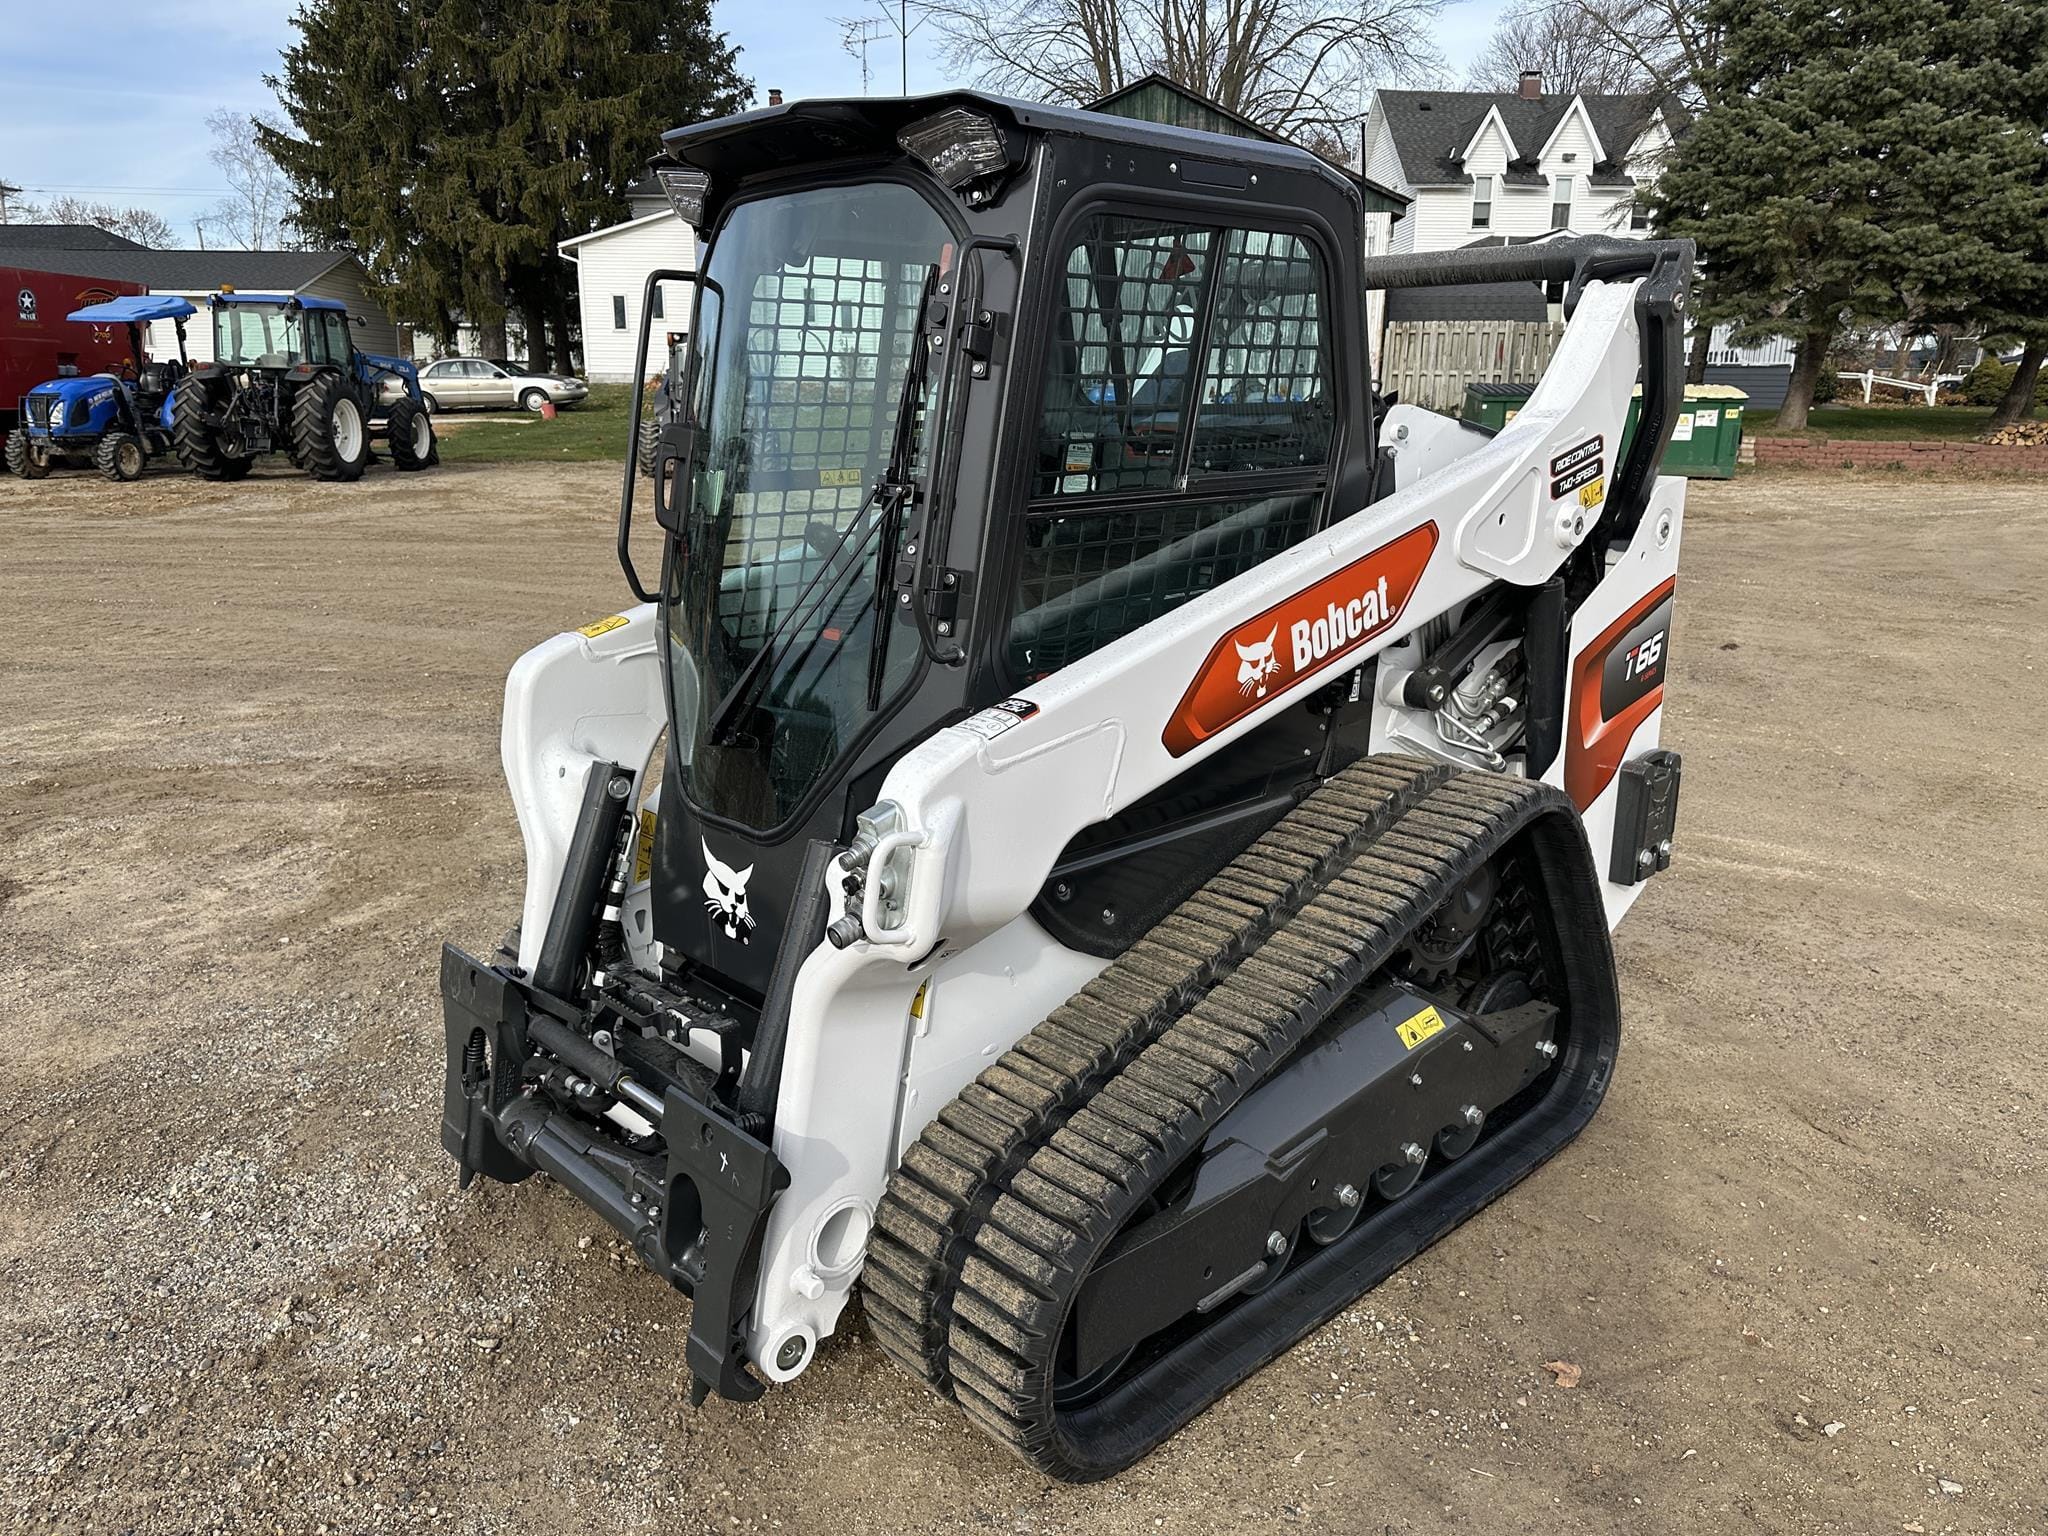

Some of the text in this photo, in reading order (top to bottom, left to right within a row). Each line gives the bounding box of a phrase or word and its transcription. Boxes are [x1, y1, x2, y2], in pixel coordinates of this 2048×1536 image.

[1559, 462, 1599, 493] TWO-SPEED
[1290, 575, 1390, 673] Bobcat
[1624, 630, 1665, 682] T66
